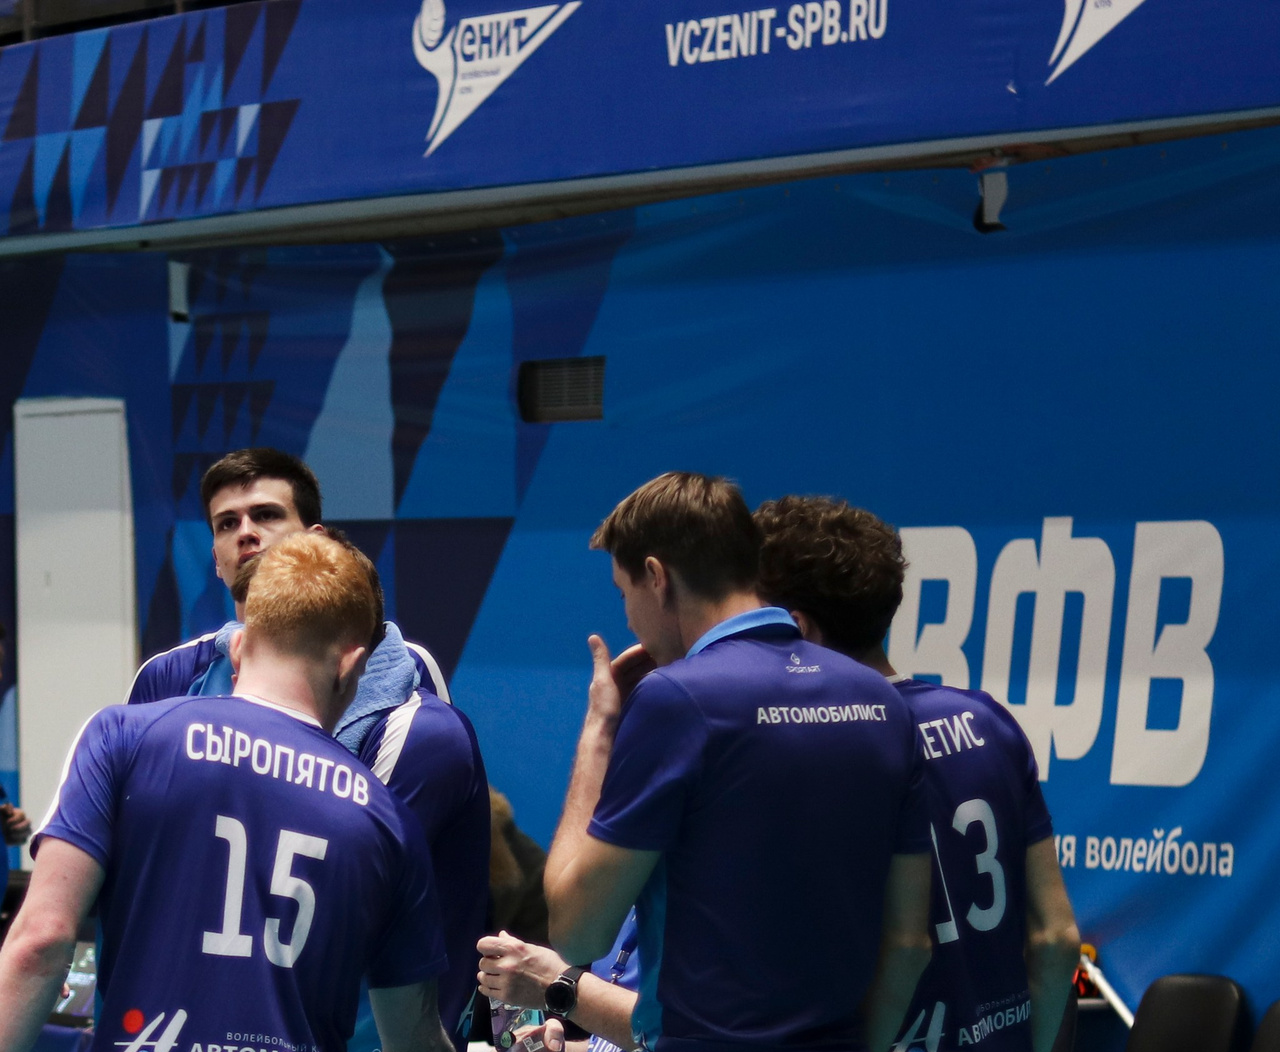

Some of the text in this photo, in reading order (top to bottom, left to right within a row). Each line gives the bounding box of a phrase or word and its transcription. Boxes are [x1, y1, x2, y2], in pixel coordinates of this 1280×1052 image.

[665, 0, 889, 67] VCZENIT-SPB.RU
[888, 516, 1225, 788] ВФВ
[756, 704, 888, 725] АВТОМОБИЛИСТ
[917, 711, 986, 760] ЕТИС
[185, 723, 370, 807] СЫРОПЯТОВ
[1085, 826, 1235, 878] волейбола
[201, 814, 329, 969] 15
